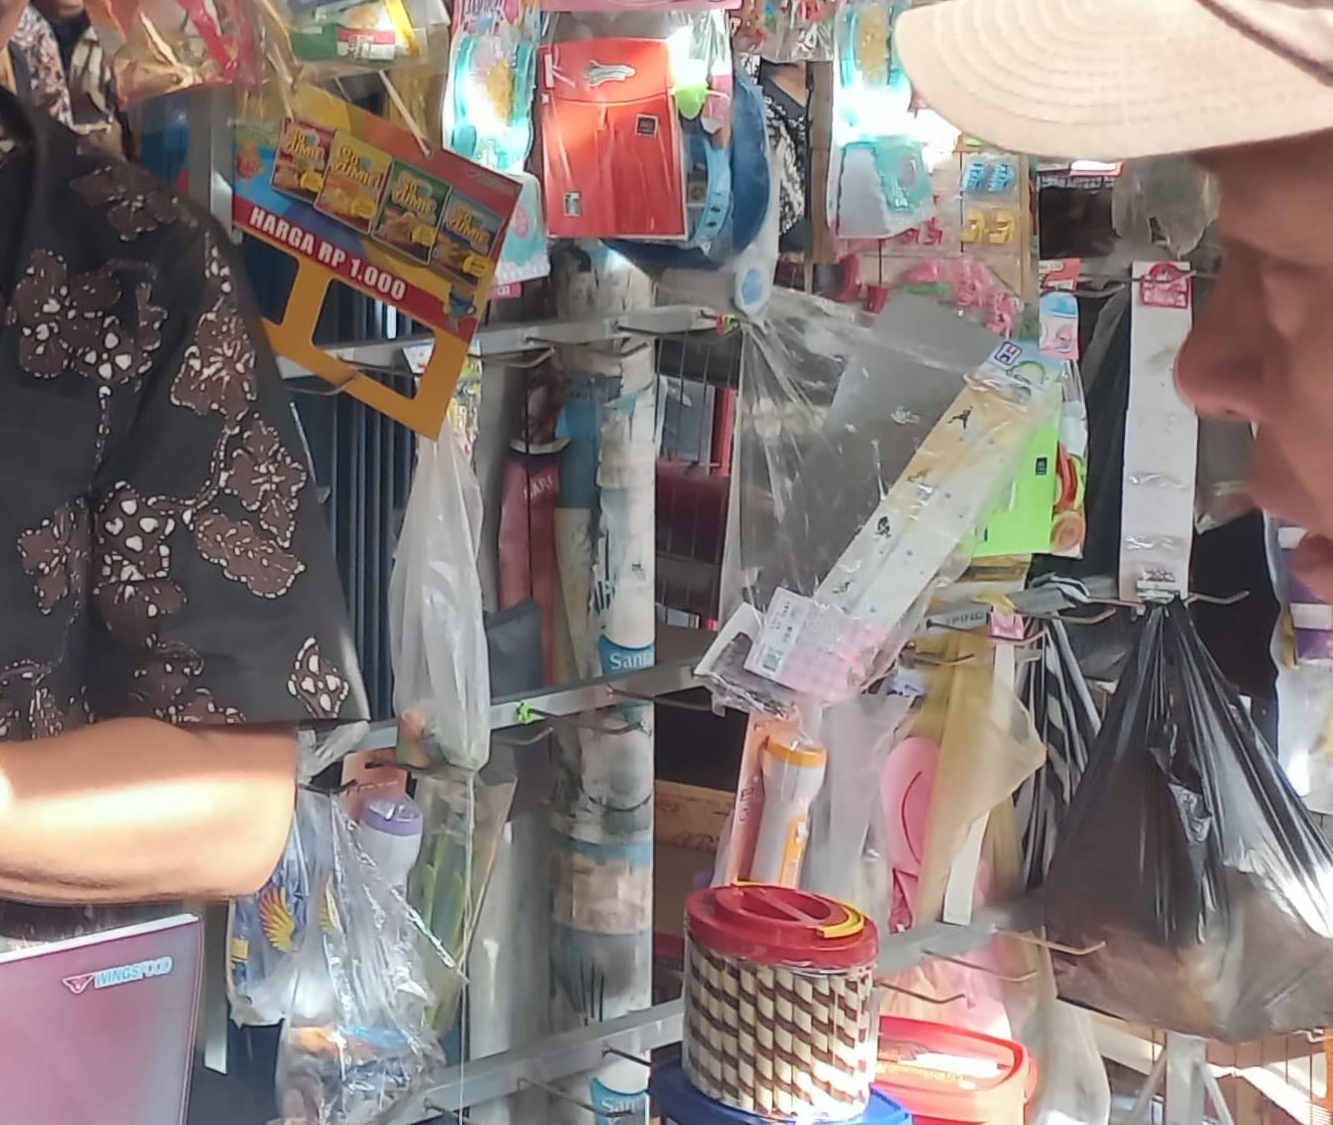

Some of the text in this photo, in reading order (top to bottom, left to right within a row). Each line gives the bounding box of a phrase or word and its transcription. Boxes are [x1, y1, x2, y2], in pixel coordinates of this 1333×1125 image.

[249, 206, 407, 301] HARGA RP 1.000
